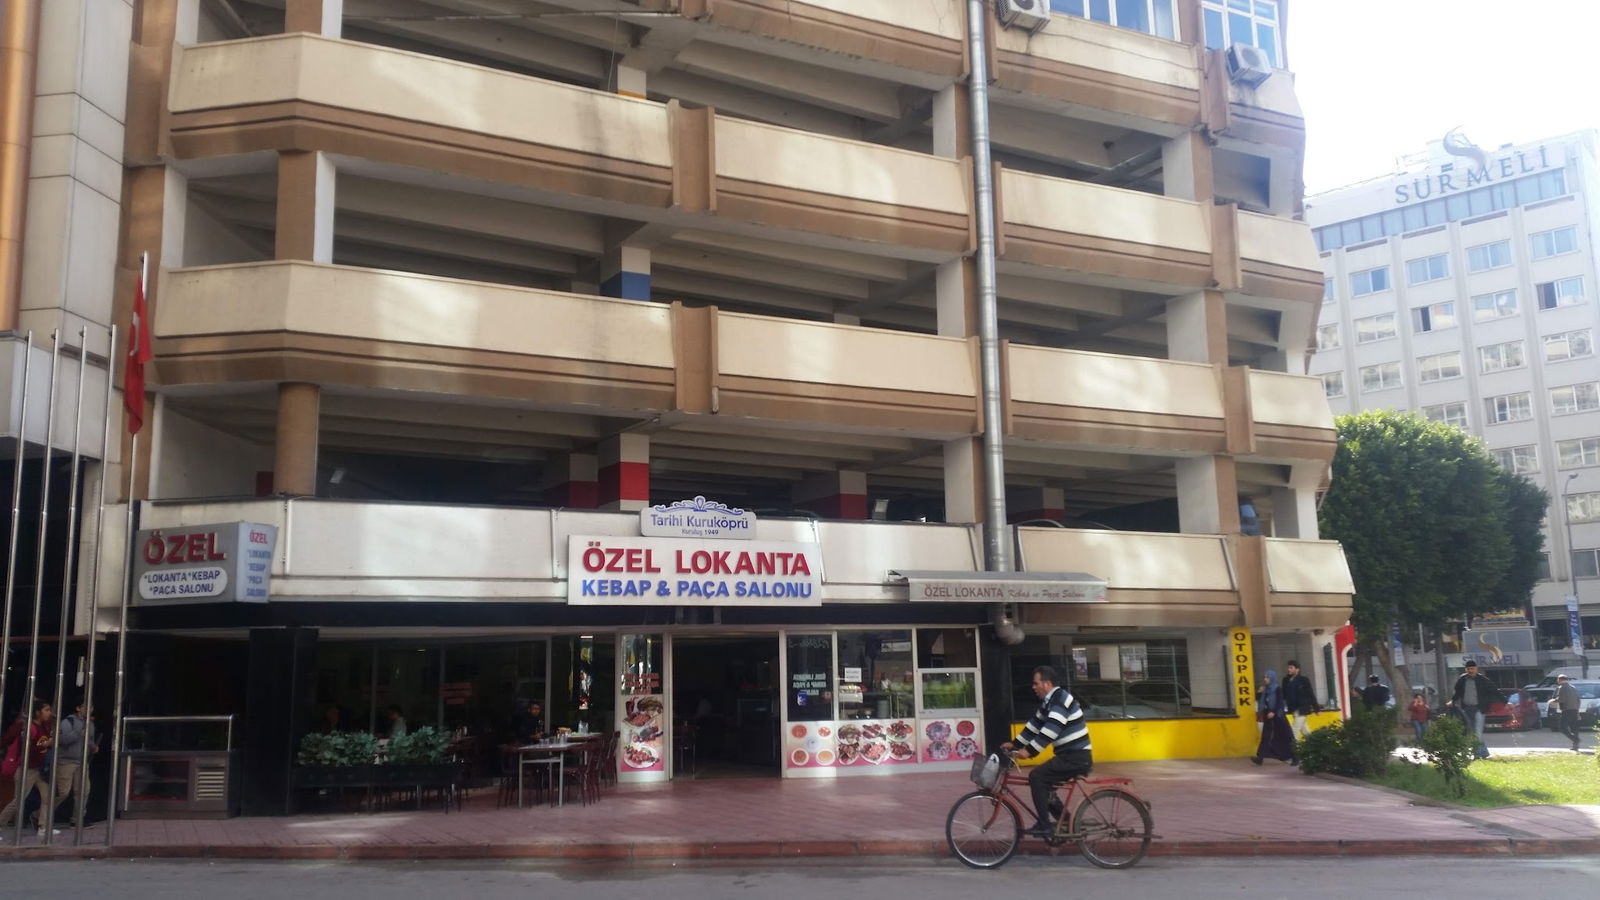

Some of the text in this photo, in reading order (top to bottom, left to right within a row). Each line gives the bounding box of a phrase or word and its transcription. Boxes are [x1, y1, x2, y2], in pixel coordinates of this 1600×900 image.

[651, 514, 748, 531] Tarihi Kuruköprü
[250, 530, 268, 544] ÖZEL
[143, 530, 226, 566] ÖZEL
[583, 541, 811, 576] ÖZEL LOKANTA
[179, 583, 214, 594] SALONU
[582, 579, 812, 599] KEBAP & PAÇA SALONU
[924, 584, 952, 598] ÖZEL
[954, 586, 1004, 598] LOKANTA
[1234, 632, 1251, 706] OTOPARK
